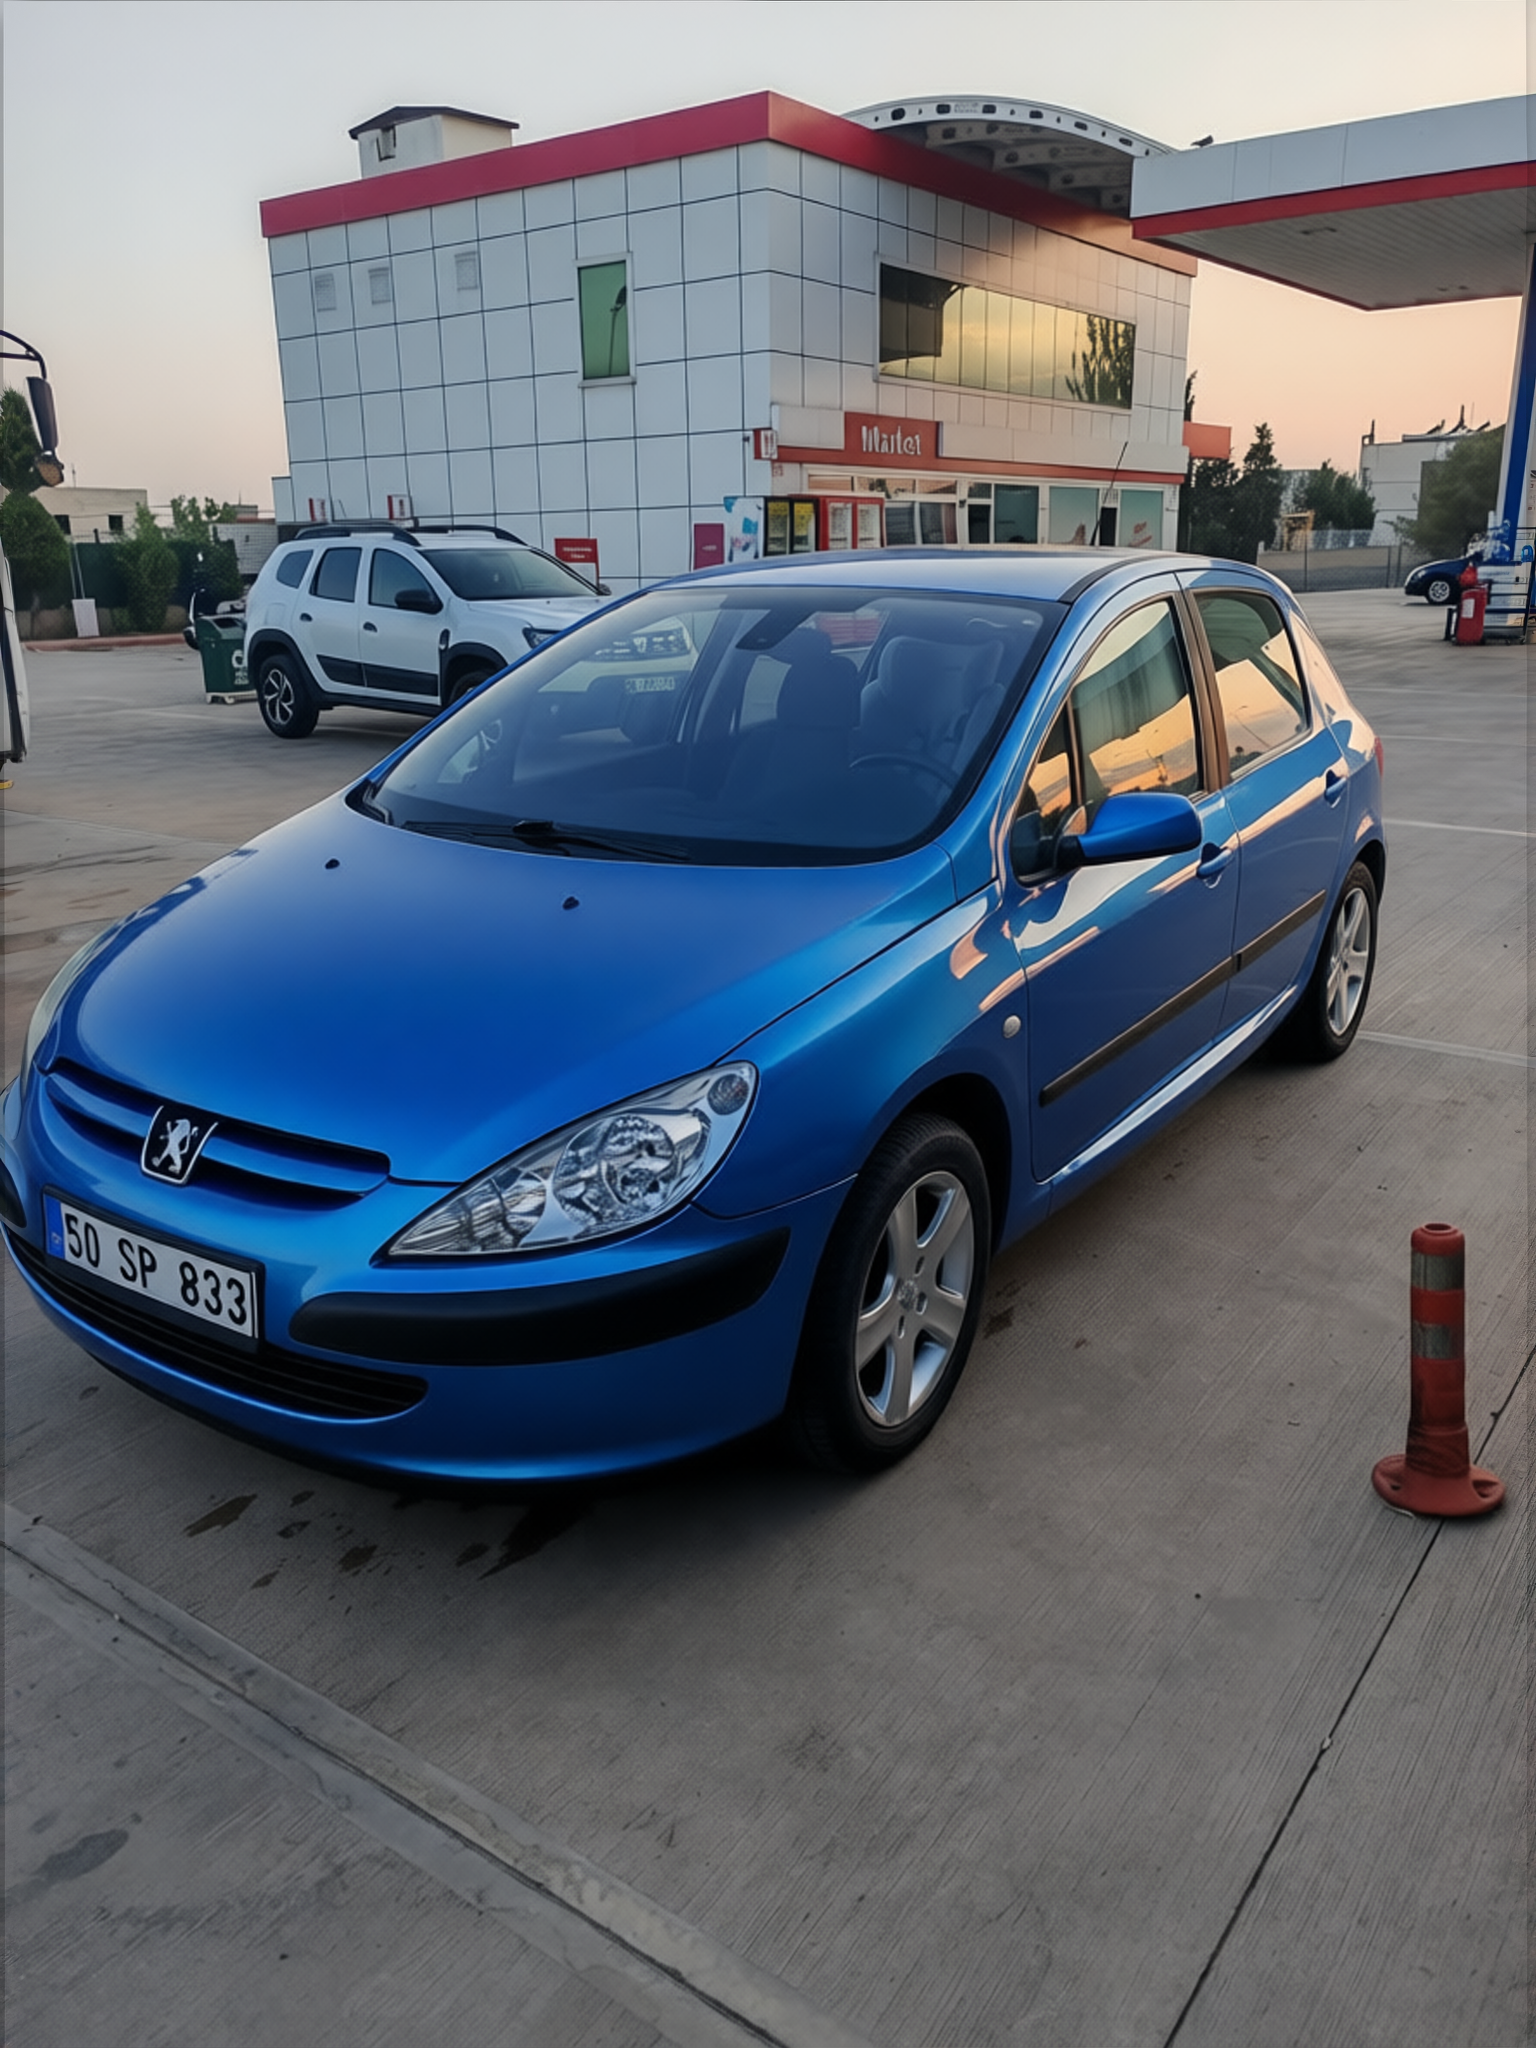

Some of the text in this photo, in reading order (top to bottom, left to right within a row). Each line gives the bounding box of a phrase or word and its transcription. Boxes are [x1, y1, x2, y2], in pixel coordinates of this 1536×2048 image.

[64, 1212, 247, 1326] 50 SP 833
